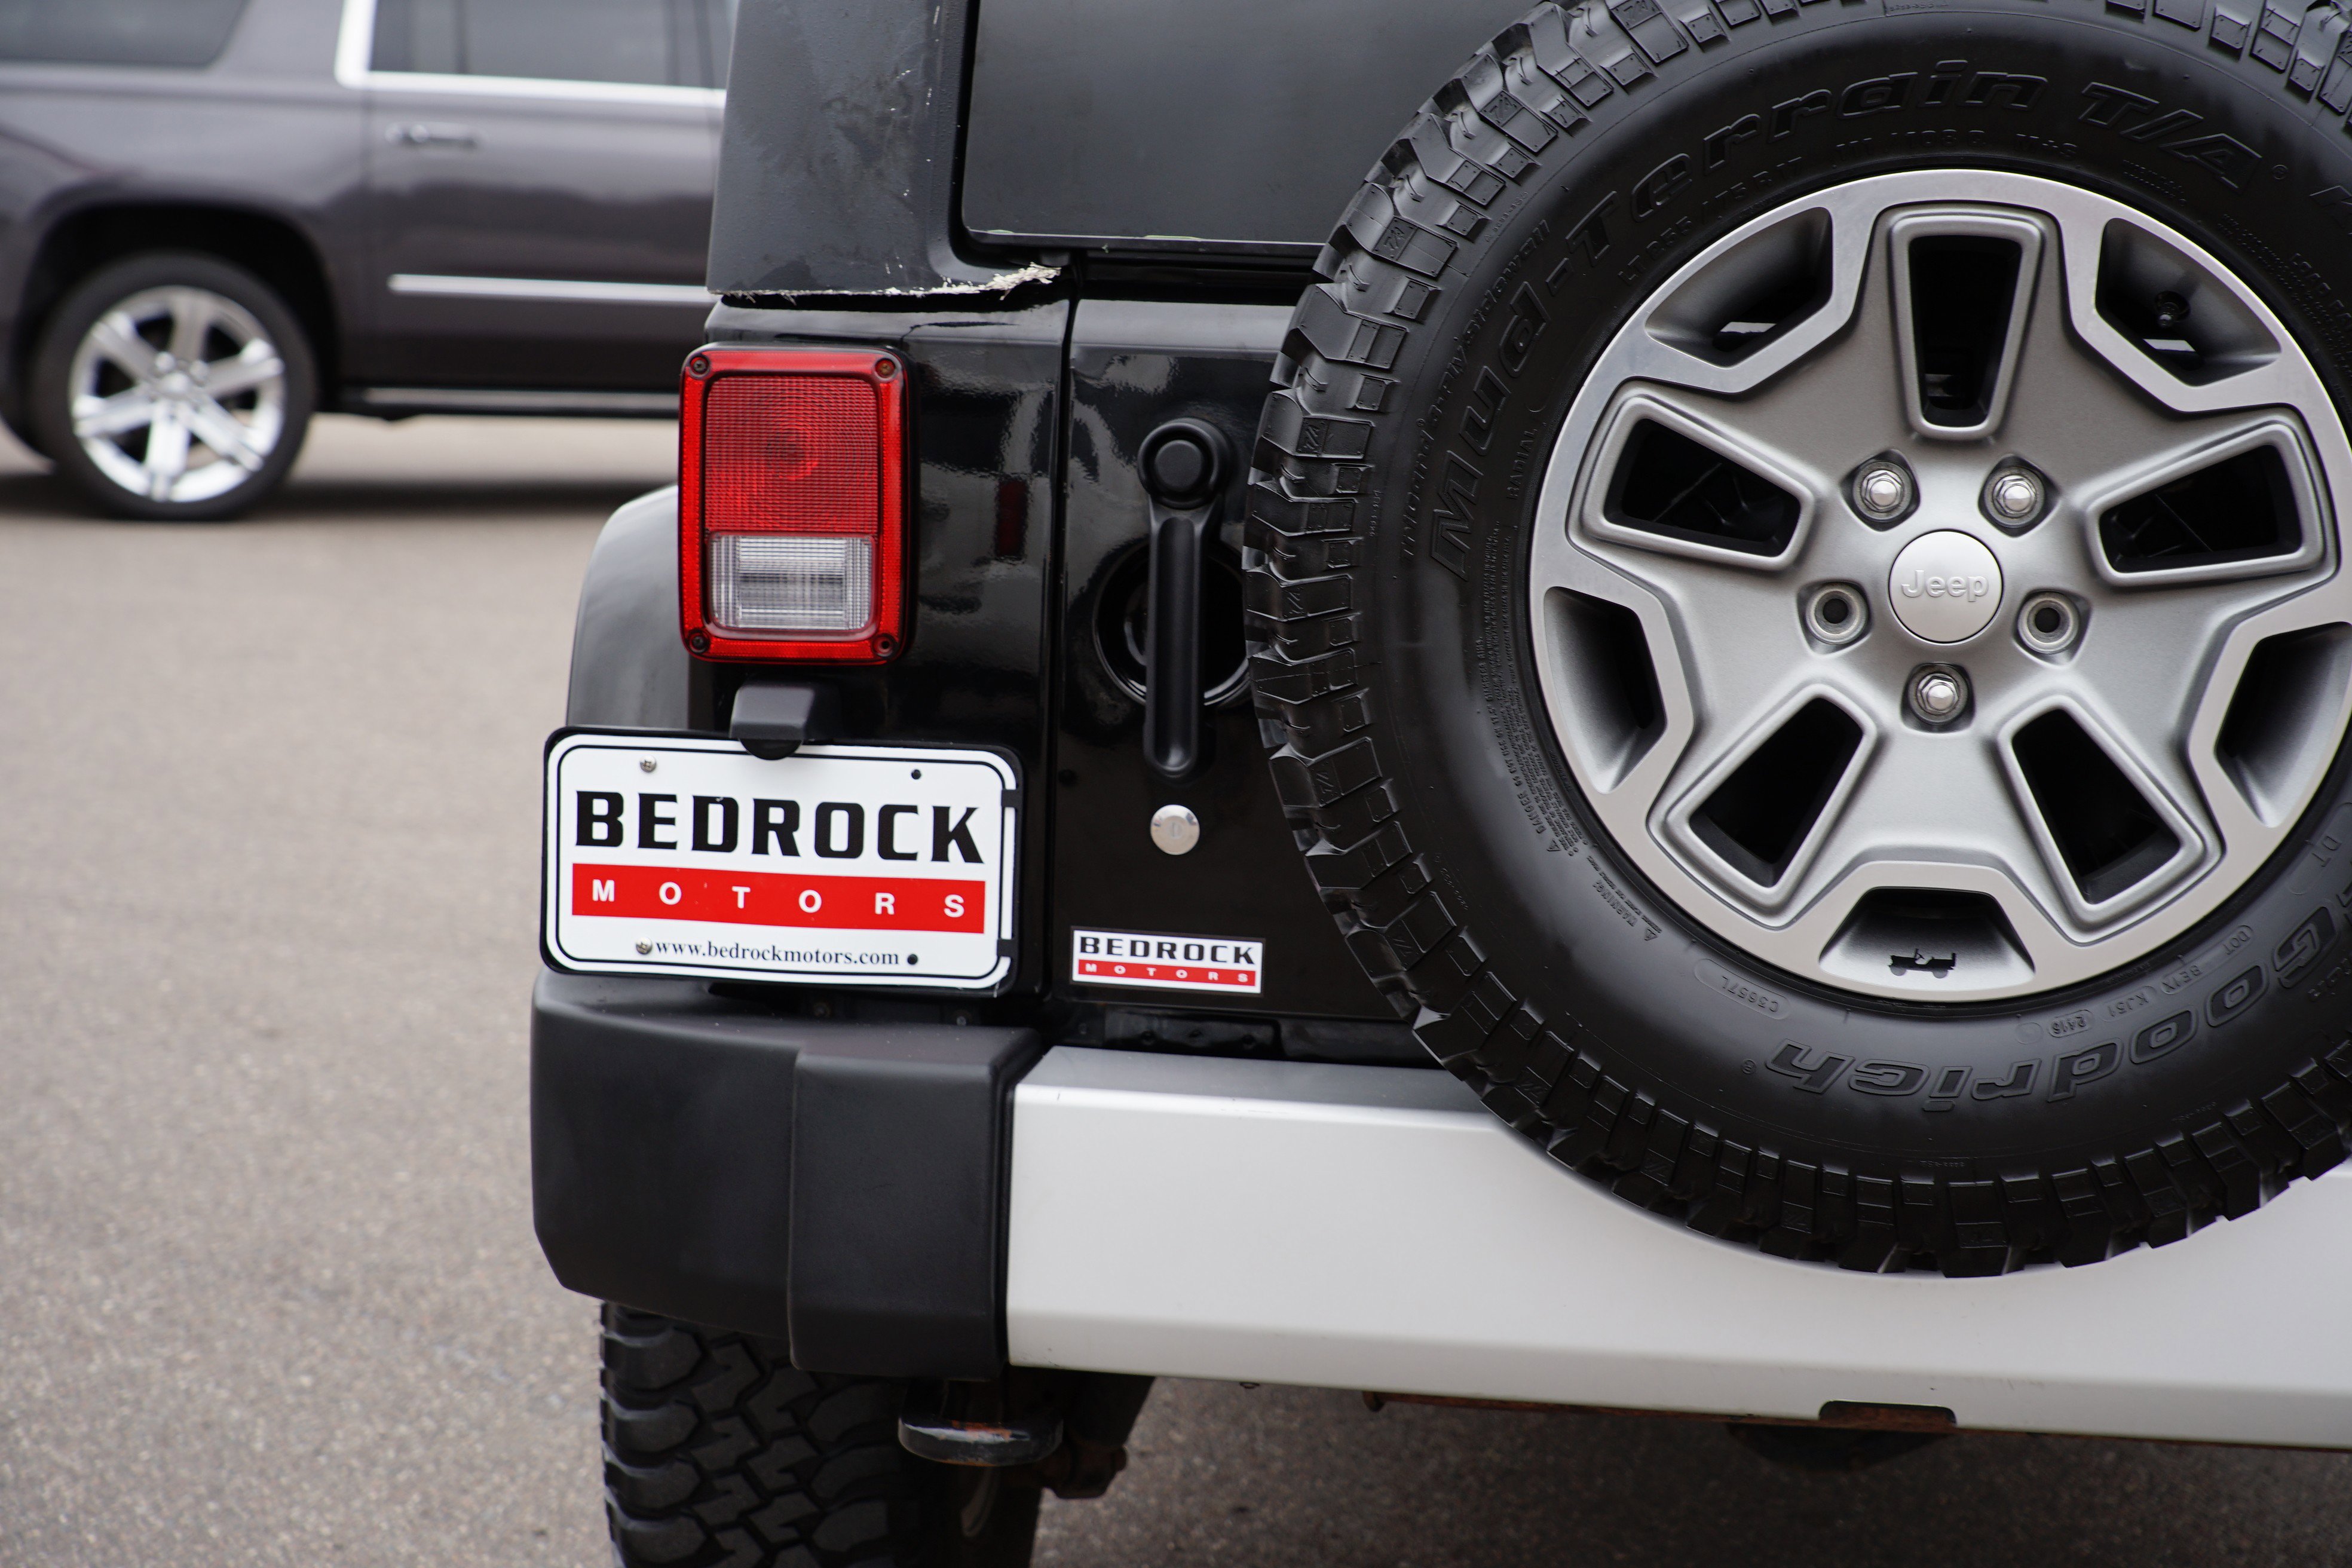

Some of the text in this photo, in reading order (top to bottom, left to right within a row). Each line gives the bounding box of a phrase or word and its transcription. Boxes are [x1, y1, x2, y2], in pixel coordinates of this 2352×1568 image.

[1431, 59, 2048, 581] Mud-Terrain
[1507, 426, 1539, 501] RADIAL
[1901, 569, 1989, 602] Jeep
[575, 790, 984, 864] BEDROCK
[592, 880, 965, 918] MOTORS
[656, 940, 899, 966] www.bedrockmotors.com
[1079, 936, 1255, 965] BEDROCK
[2223, 930, 2250, 956] DOT
[1085, 963, 1249, 983] MOTORS
[1765, 896, 2348, 1111] Goodrich
